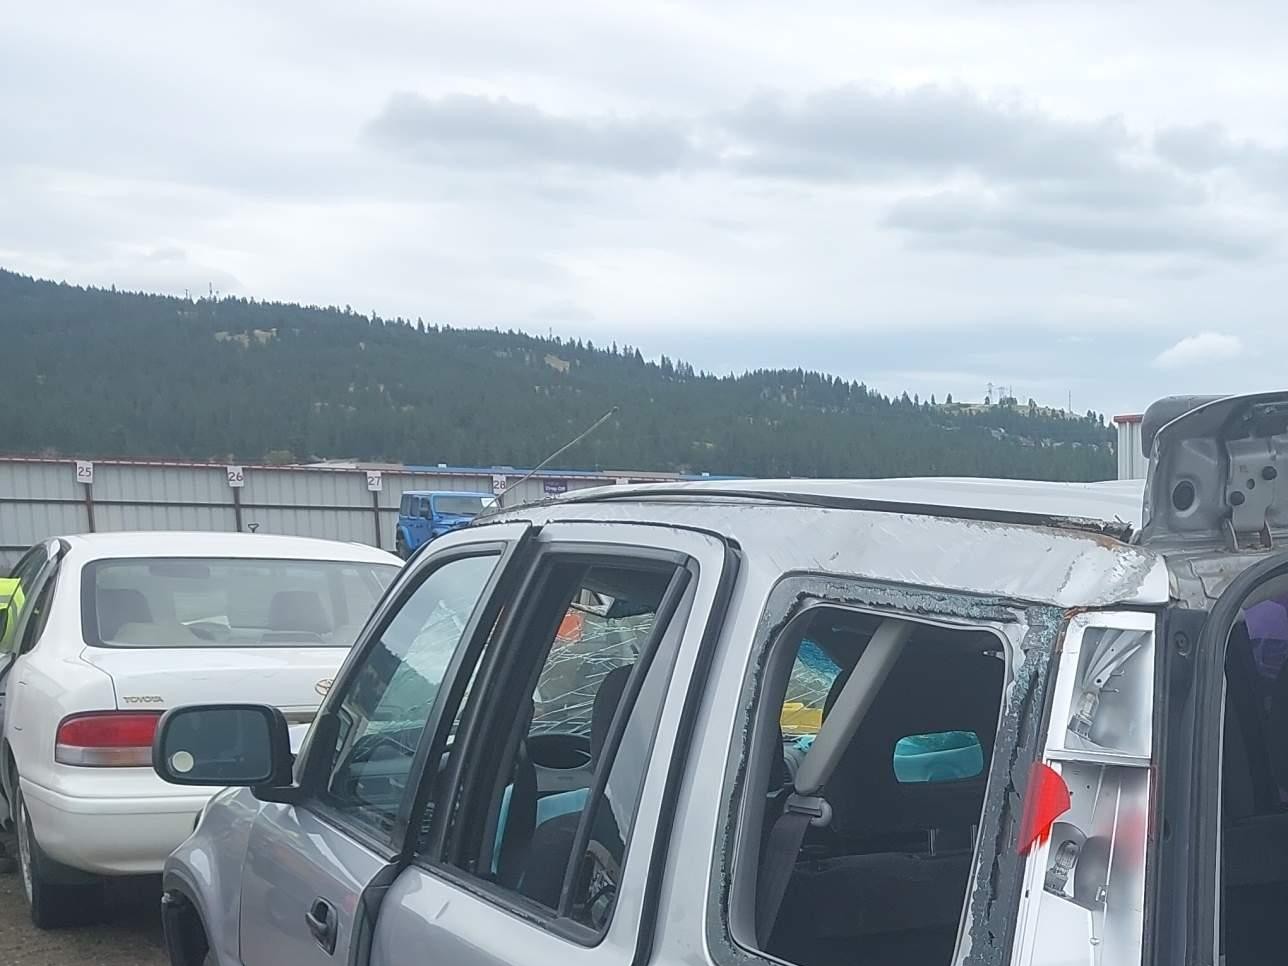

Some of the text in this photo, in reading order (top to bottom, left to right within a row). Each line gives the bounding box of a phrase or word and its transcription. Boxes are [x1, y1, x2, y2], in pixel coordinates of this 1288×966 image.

[78, 466, 92, 477] 25
[228, 471, 244, 481] 26
[368, 475, 381, 486] 27
[493, 481, 506, 490] 28
